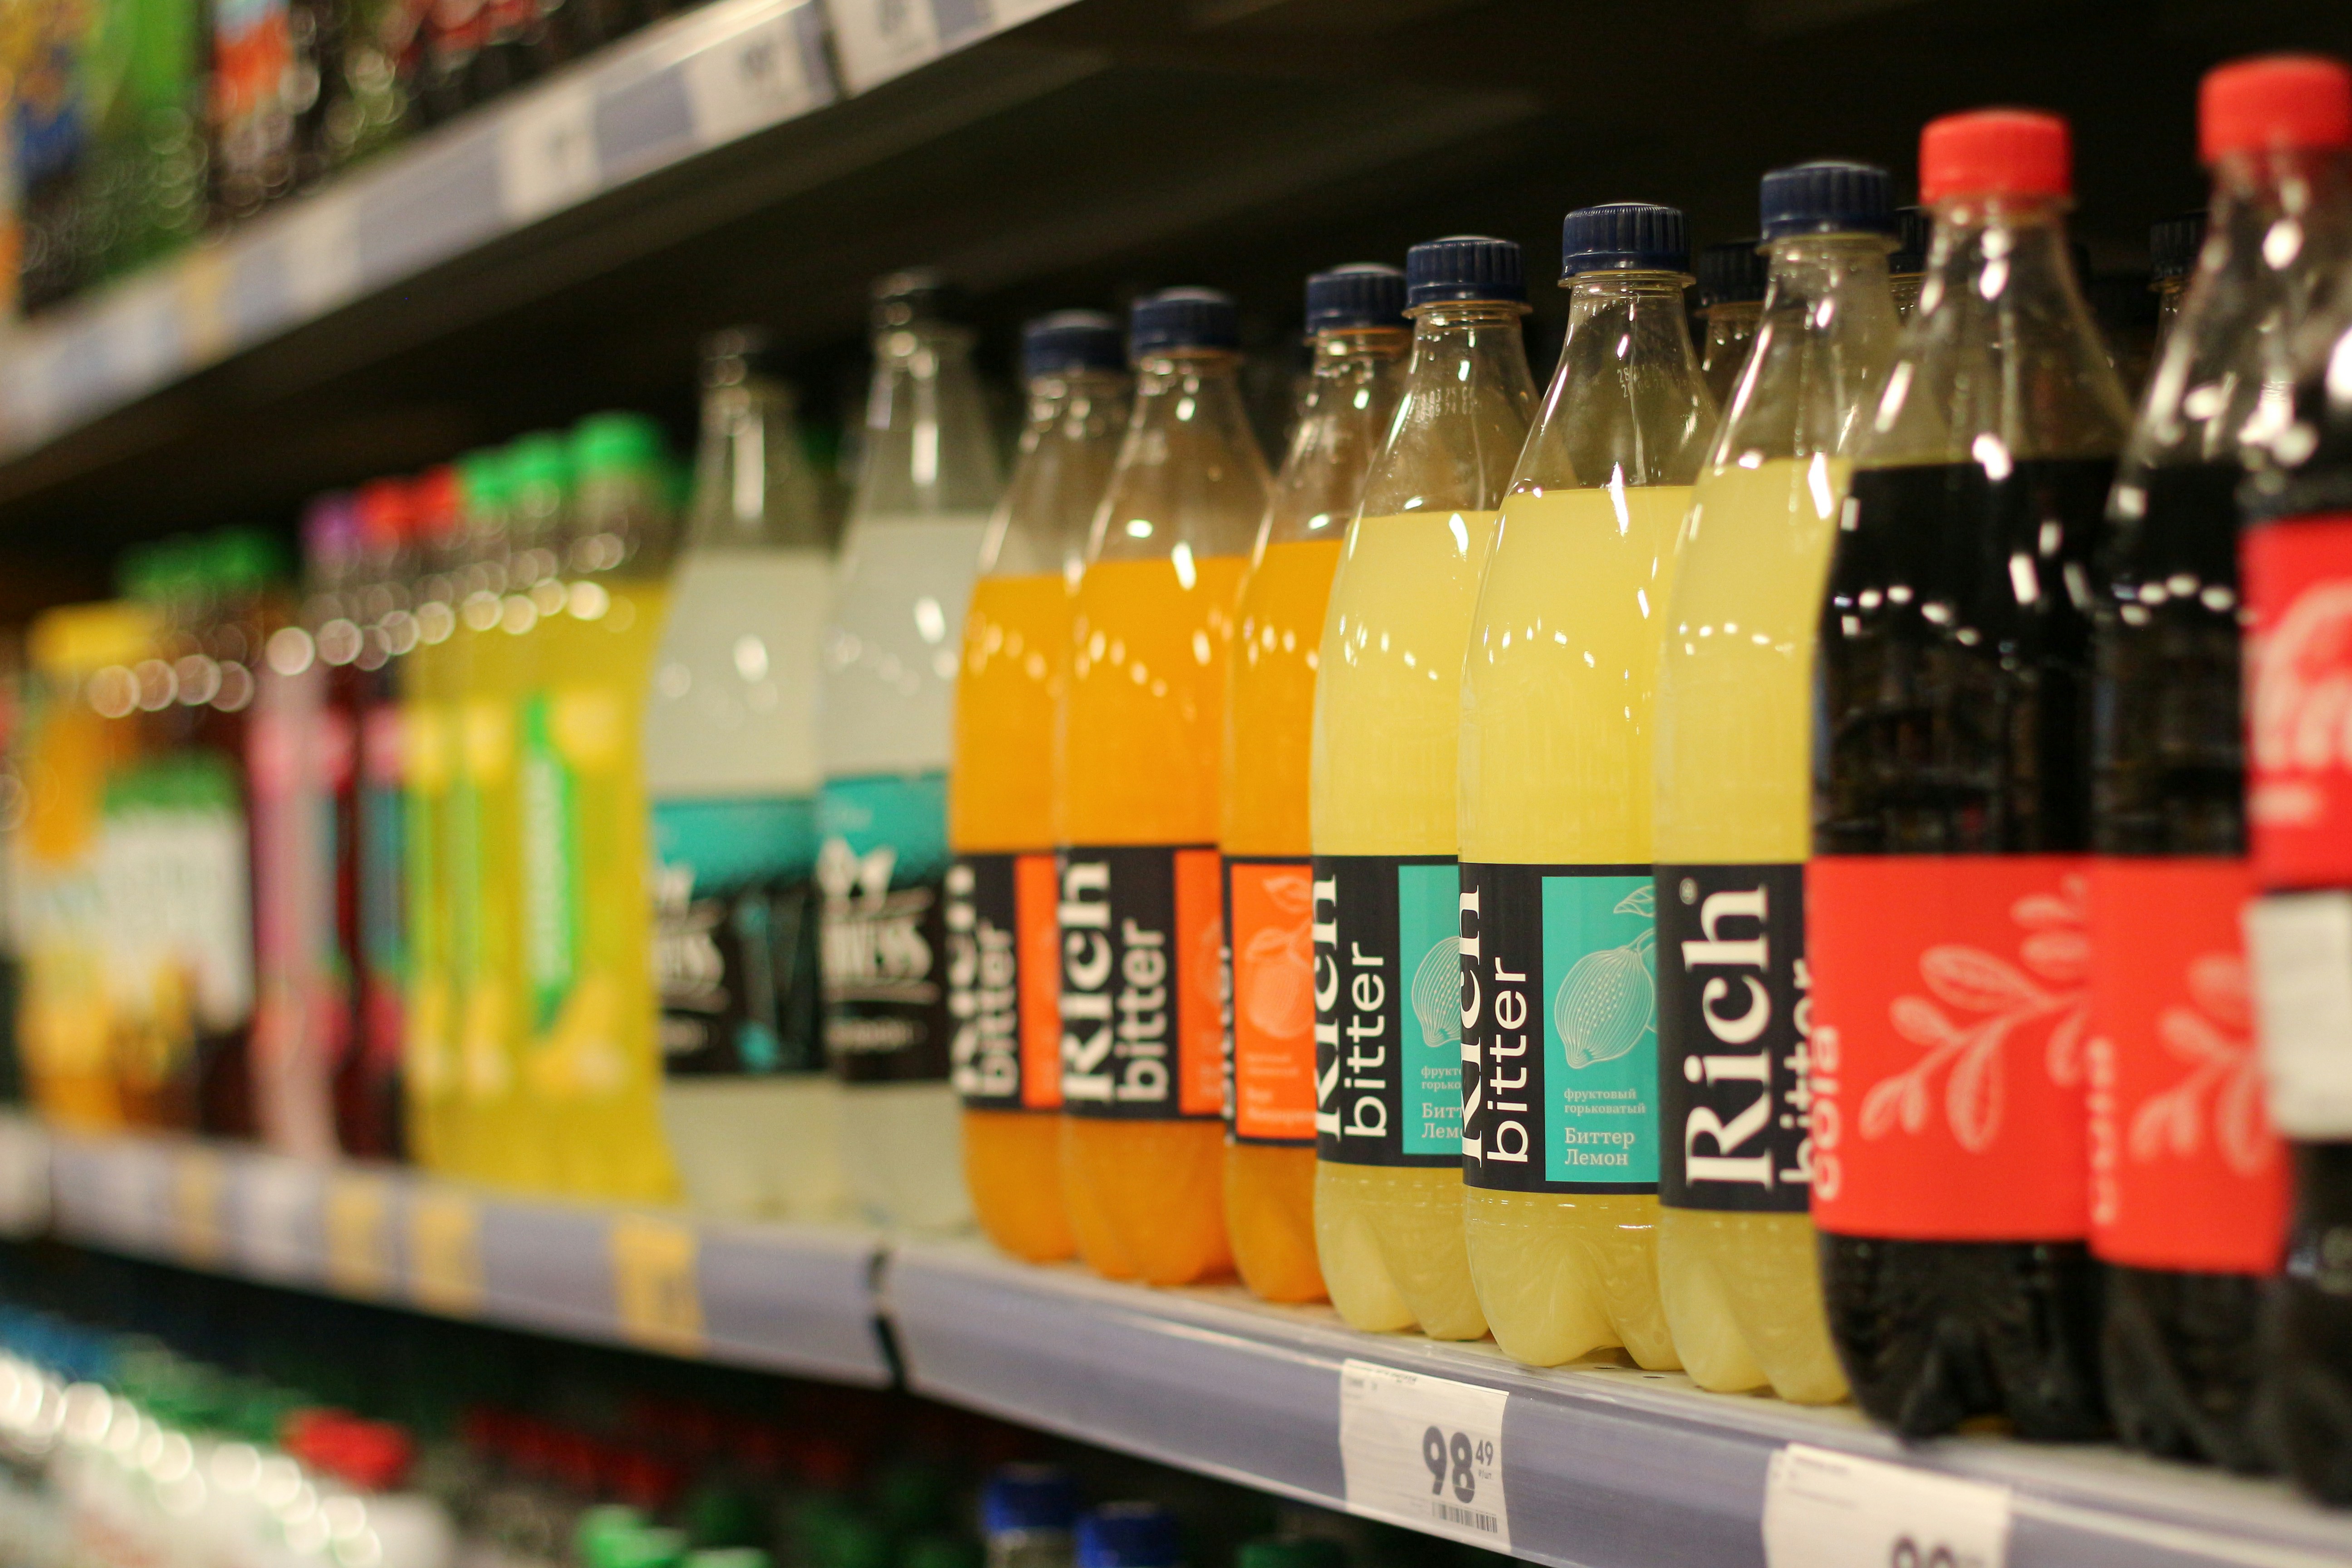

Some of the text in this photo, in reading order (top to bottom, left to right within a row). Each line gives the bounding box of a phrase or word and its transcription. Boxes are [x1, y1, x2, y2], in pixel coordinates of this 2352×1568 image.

[1114, 916, 1169, 1102] bitter
[1344, 941, 1387, 1137] bitter
[1486, 957, 1528, 1162] bitter
[1681, 883, 1774, 1191] Rich
[1421, 1066, 1461, 1079] фрукт
[1564, 1088, 1637, 1102] фруктовый
[1564, 1102, 1646, 1117] горьковатый
[1564, 1127, 1636, 1149] Биттер
[1564, 1149, 1628, 1166] Лемон
[1423, 1426, 1493, 1503] 98 49
